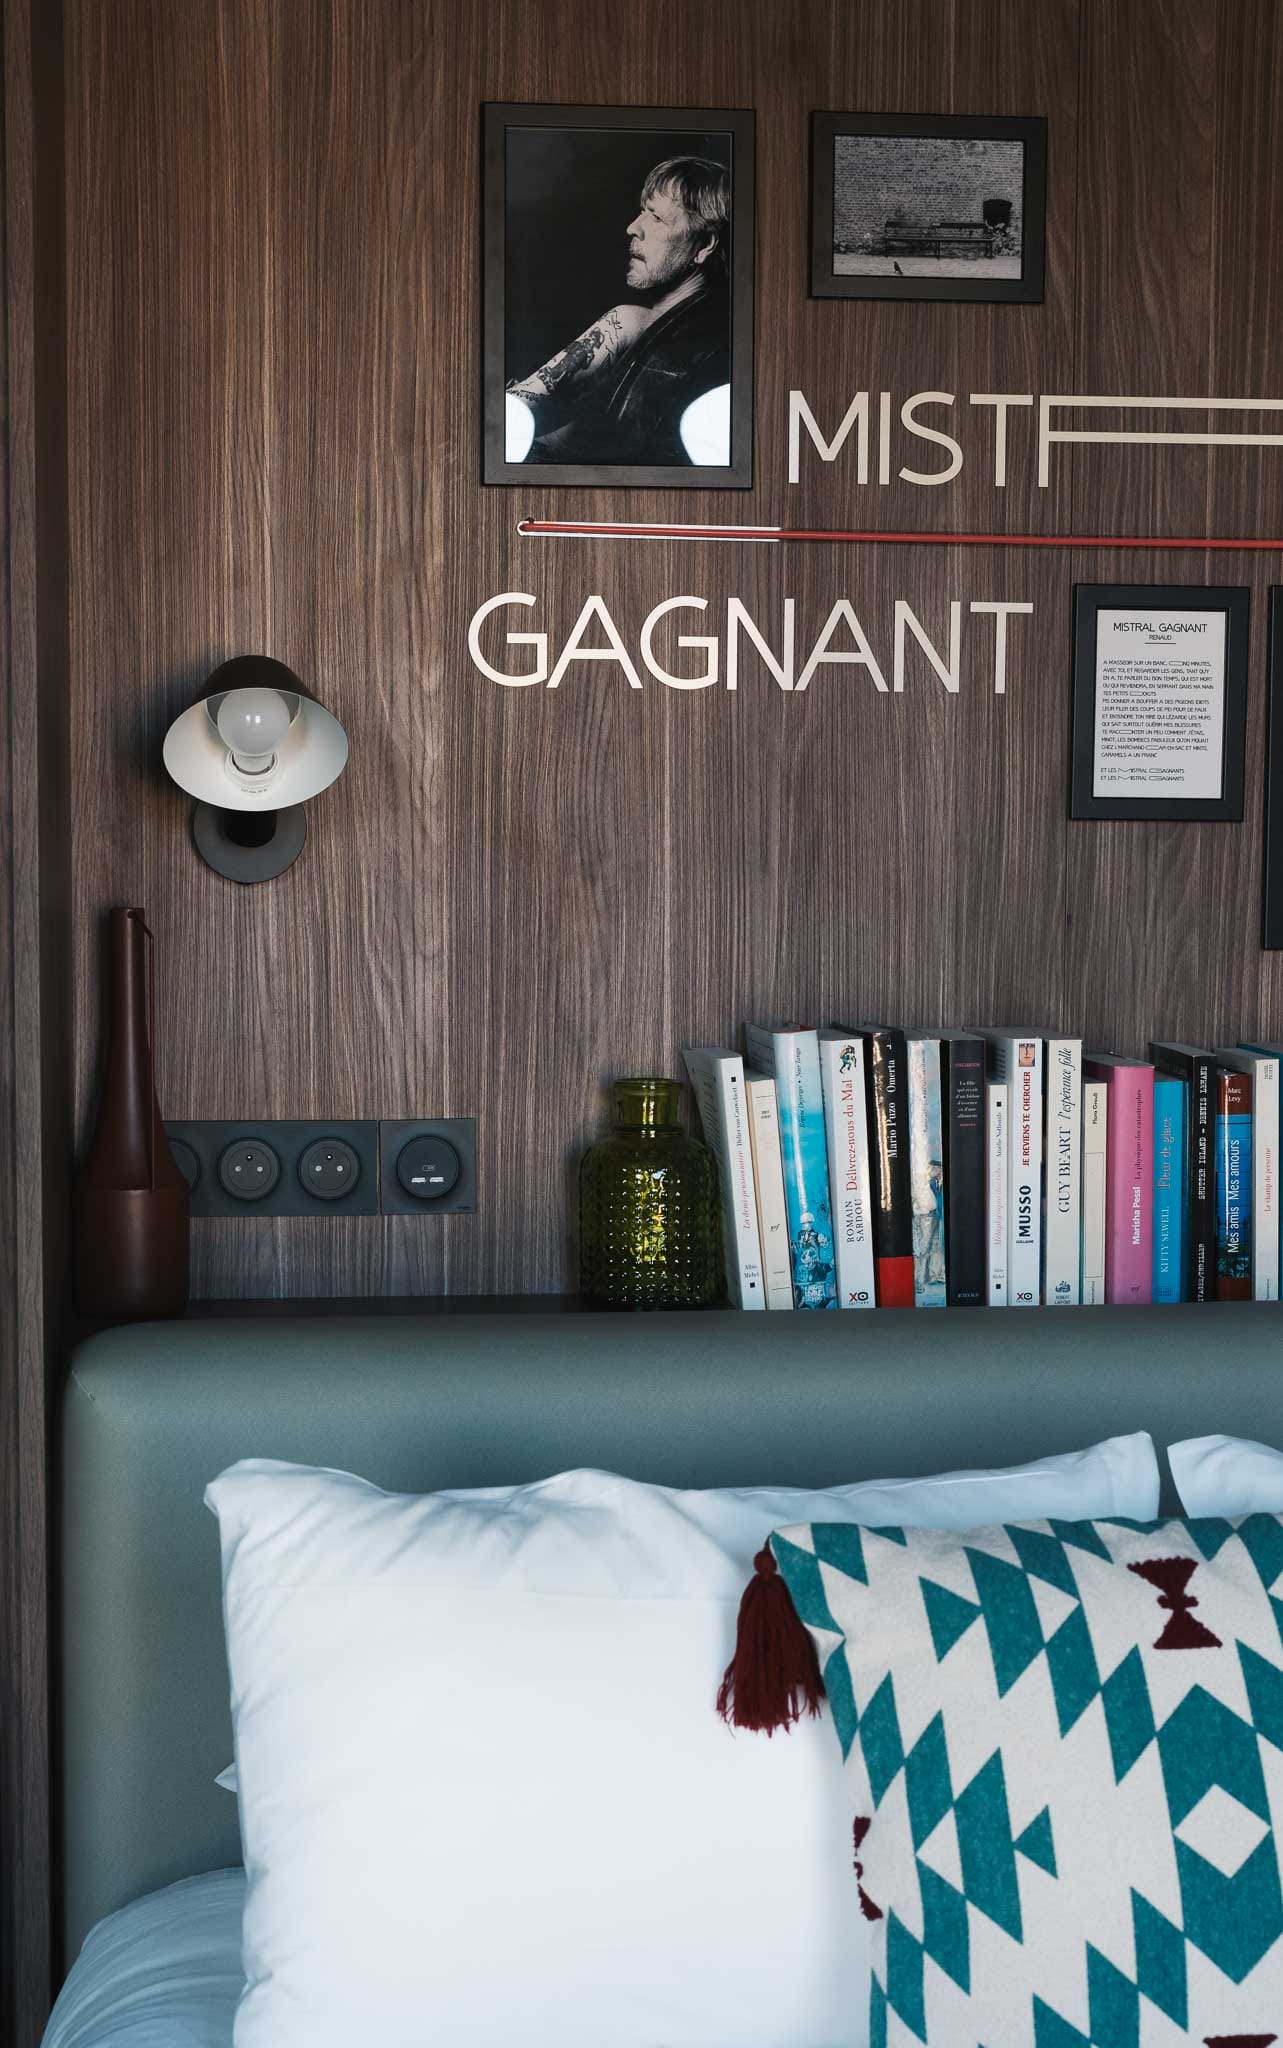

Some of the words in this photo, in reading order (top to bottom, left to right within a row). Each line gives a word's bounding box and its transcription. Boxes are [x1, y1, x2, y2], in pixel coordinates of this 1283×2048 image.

[1113, 622, 1155, 632] MISTRAL
[1158, 623, 1208, 633] GAGNANT
[467, 591, 1034, 695] GAGNANT
[1058, 1048, 1076, 1071] folle
[841, 1079, 853, 1101] Mal
[886, 1060, 896, 1092] Omerta
[843, 1104, 854, 1117] du
[886, 1103, 896, 1126] Puzo
[1023, 1113, 1030, 1122] TE
[846, 1120, 858, 1191] Délivrez-nous
[886, 1129, 898, 1158] Mario
[1058, 1127, 1070, 1177] BEART
[1229, 1140, 1239, 1176] amours
[1058, 1181, 1070, 1213] GUY
[1132, 1187, 1141, 1208] Pessl
[1228, 1179, 1239, 1200] Mes
[845, 1200, 854, 1242] ROMAIN
[855, 1198, 864, 1242] SARDOU
[1019, 1186, 1031, 1237] MUSSO
[1228, 1207, 1239, 1229] amis
[1265, 1204, 1271, 1212] Le
[1132, 1210, 1141, 1245] Marisha
[1160, 1206, 1169, 1242] SEWELL
[1227, 1232, 1239, 1253] Mes
[1160, 1244, 1169, 1273] KITTY
